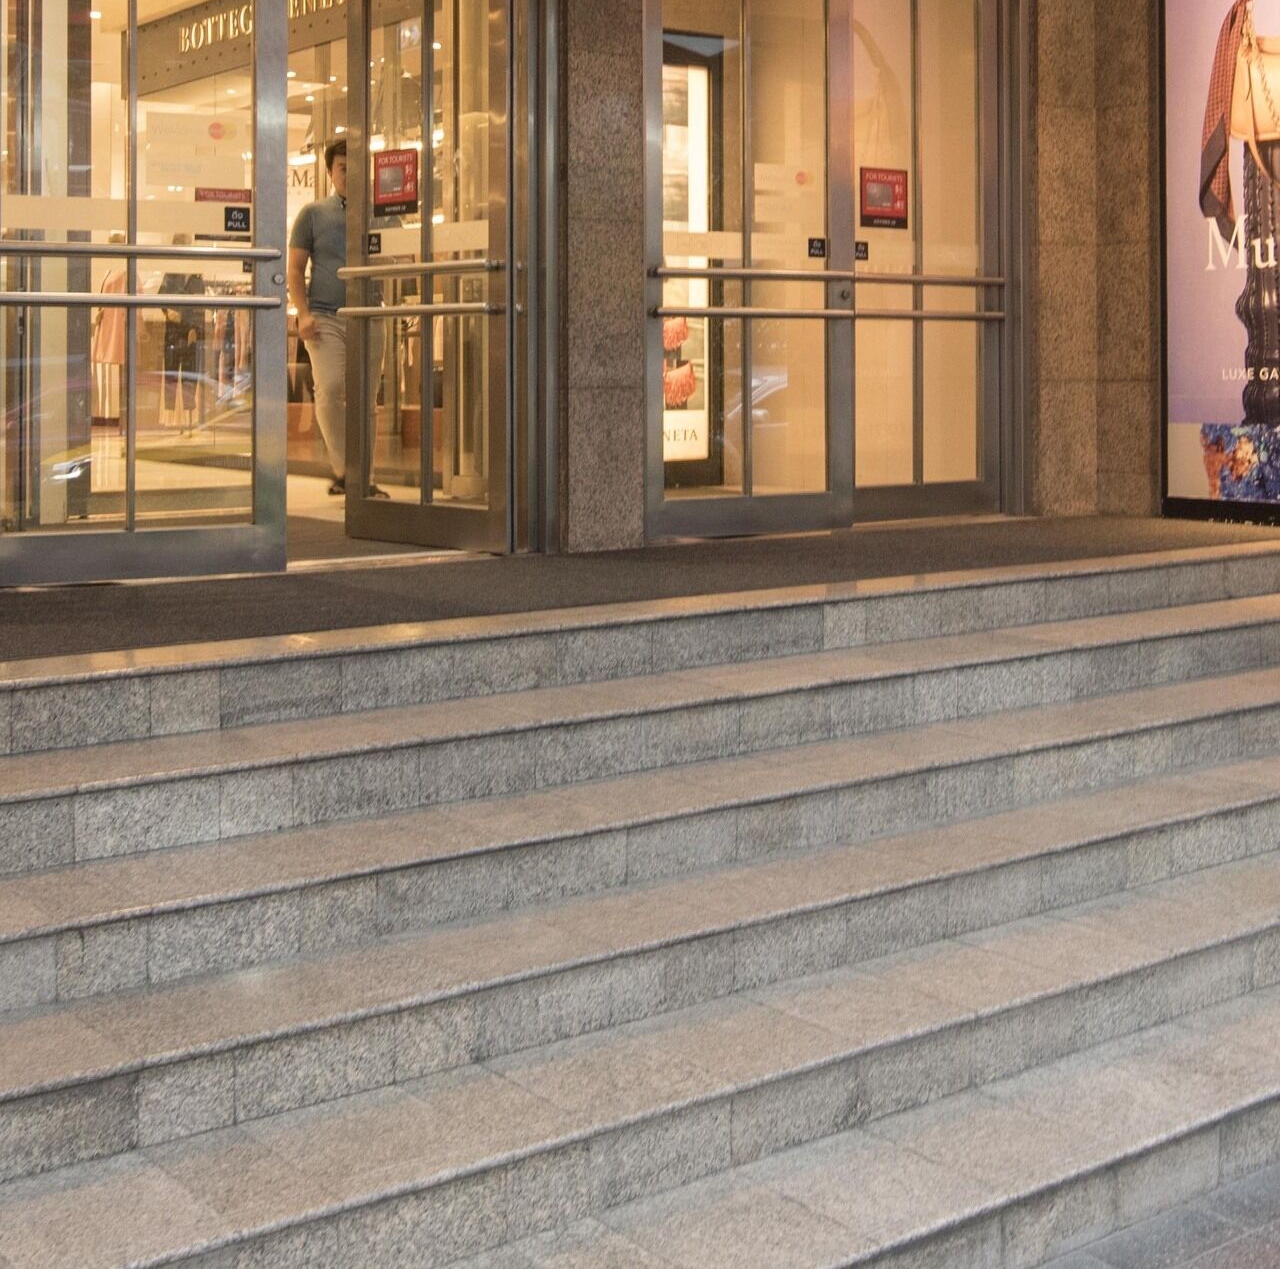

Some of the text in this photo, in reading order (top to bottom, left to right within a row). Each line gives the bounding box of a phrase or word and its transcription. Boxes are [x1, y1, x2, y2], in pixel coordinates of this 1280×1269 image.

[179, 4, 253, 53] BOTTEG
[227, 221, 247, 229] PULL
[1221, 367, 1255, 380] LUXE
[663, 429, 698, 442] NETA
